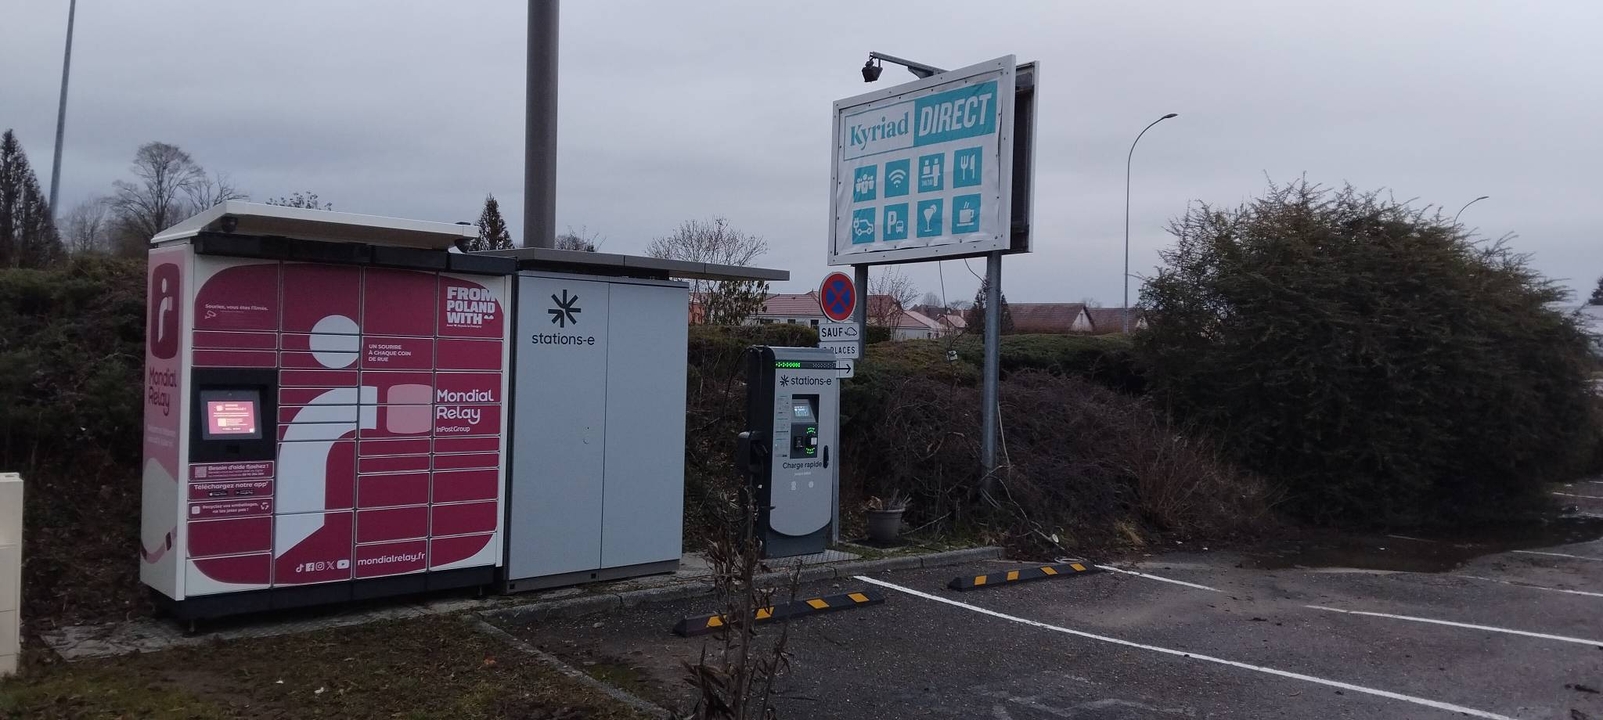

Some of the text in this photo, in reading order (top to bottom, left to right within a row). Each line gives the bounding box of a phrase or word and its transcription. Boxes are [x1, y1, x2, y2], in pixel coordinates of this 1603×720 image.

[850, 93, 992, 151] Kyriad DIRECT
[887, 211, 897, 234] P
[447, 286, 496, 301] FROM
[446, 300, 495, 313] POLAND
[446, 312, 482, 324] WITH
[821, 327, 843, 337] SAUF
[532, 333, 595, 345] stations-e
[149, 366, 177, 387] Mondial
[791, 376, 832, 386] stations-e
[148, 386, 170, 416] Relay
[437, 389, 494, 402] Mondial
[437, 406, 480, 424] Relay
[782, 461, 822, 470] Charge rapide
[357, 552, 425, 565] mondialrelay.fr
